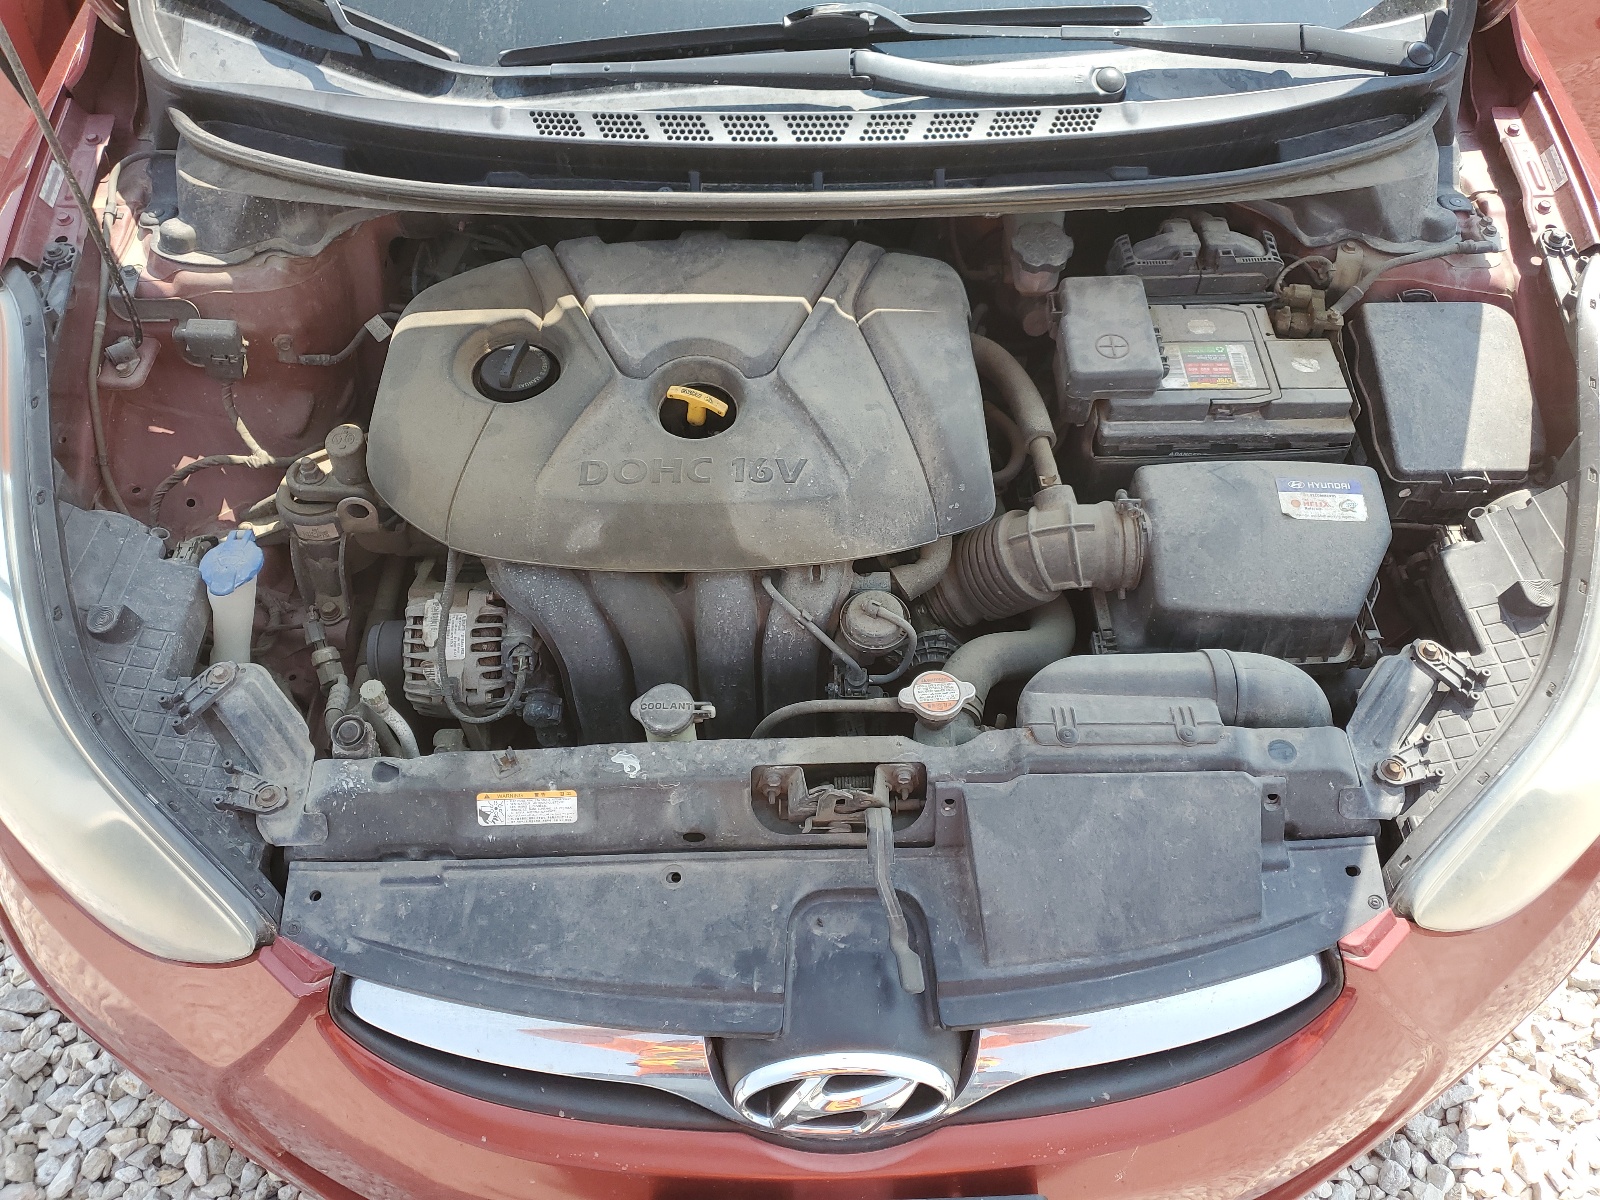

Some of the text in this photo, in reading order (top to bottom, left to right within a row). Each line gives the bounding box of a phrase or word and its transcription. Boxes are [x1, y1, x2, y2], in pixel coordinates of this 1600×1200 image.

[578, 457, 808, 486] DOHC 16V
[1307, 481, 1351, 489] HYUNDAI
[640, 702, 693, 711] COOLANT
